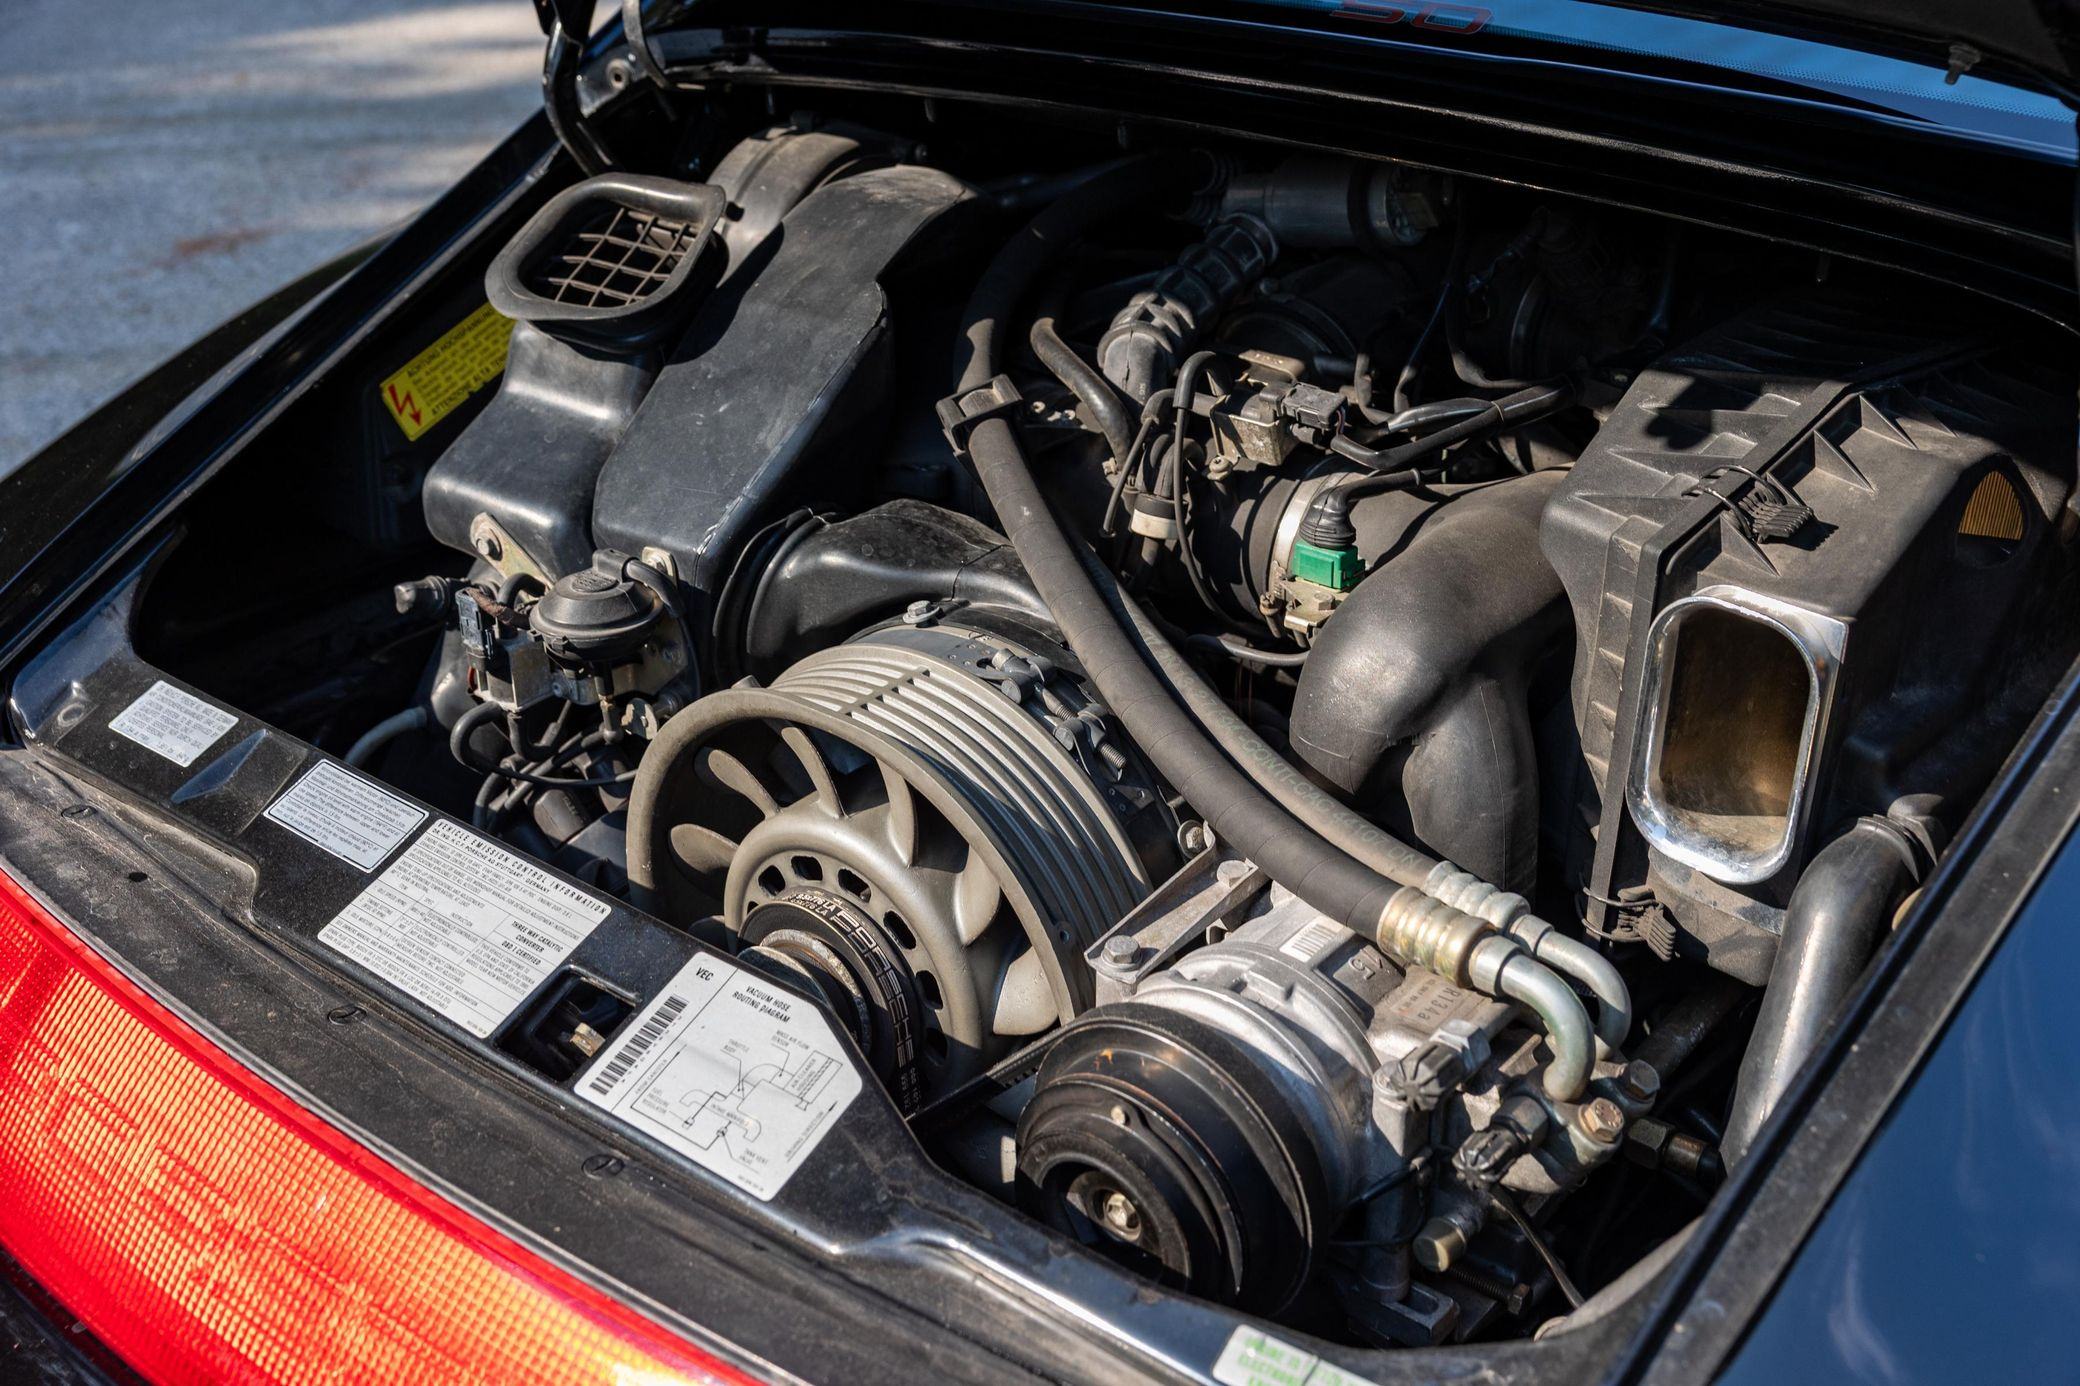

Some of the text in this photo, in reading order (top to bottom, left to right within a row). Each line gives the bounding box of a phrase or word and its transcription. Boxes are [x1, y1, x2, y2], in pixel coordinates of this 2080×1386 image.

[438, 822, 469, 841] VEHICLE
[471, 839, 509, 862] EMISSION
[512, 861, 546, 883] CONTROL
[550, 882, 606, 914] INFORMATION
[465, 845, 487, 860] PORSCHE
[525, 878, 549, 892] GERMANY
[512, 921, 563, 952] THREE WAY CATALYTIC
[516, 934, 544, 952] CONVERTER
[501, 940, 513, 949] OBD
[516, 949, 541, 965] CERTIFIED
[696, 967, 713, 981] VEC
[836, 909, 915, 1060] PORSCHE
[733, 991, 790, 1022] ROUTING DIAGRAM
[746, 986, 790, 1011] VACUUM HOSE
[829, 915, 907, 1068] PORSCHE
